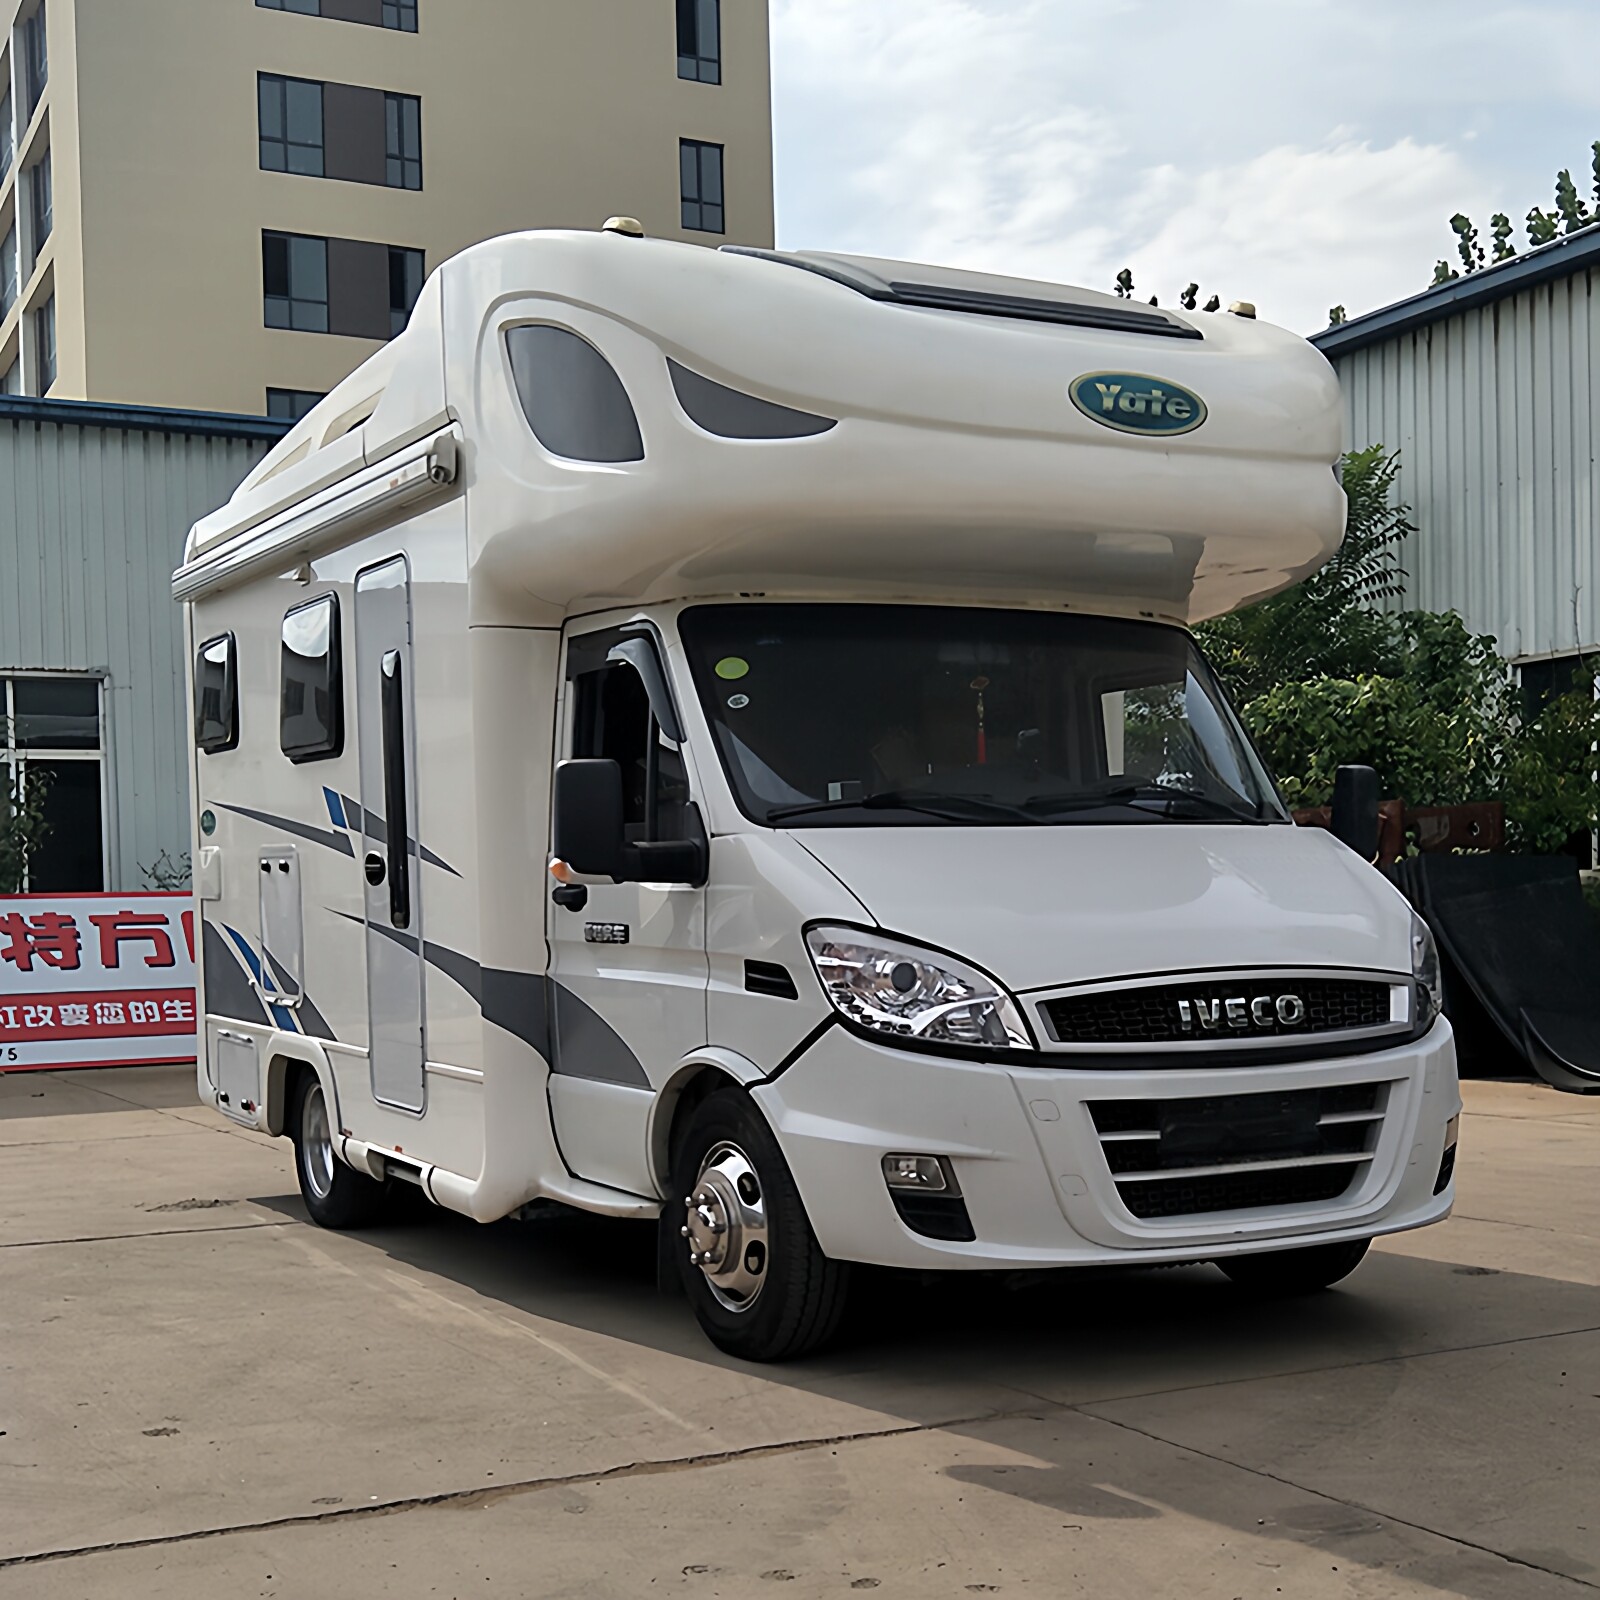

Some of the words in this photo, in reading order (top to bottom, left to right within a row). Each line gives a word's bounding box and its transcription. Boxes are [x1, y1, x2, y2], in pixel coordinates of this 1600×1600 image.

[1094, 383, 1192, 419] Yate
[0, 910, 195, 971] 特方
[1178, 994, 1305, 1031] IVECO
